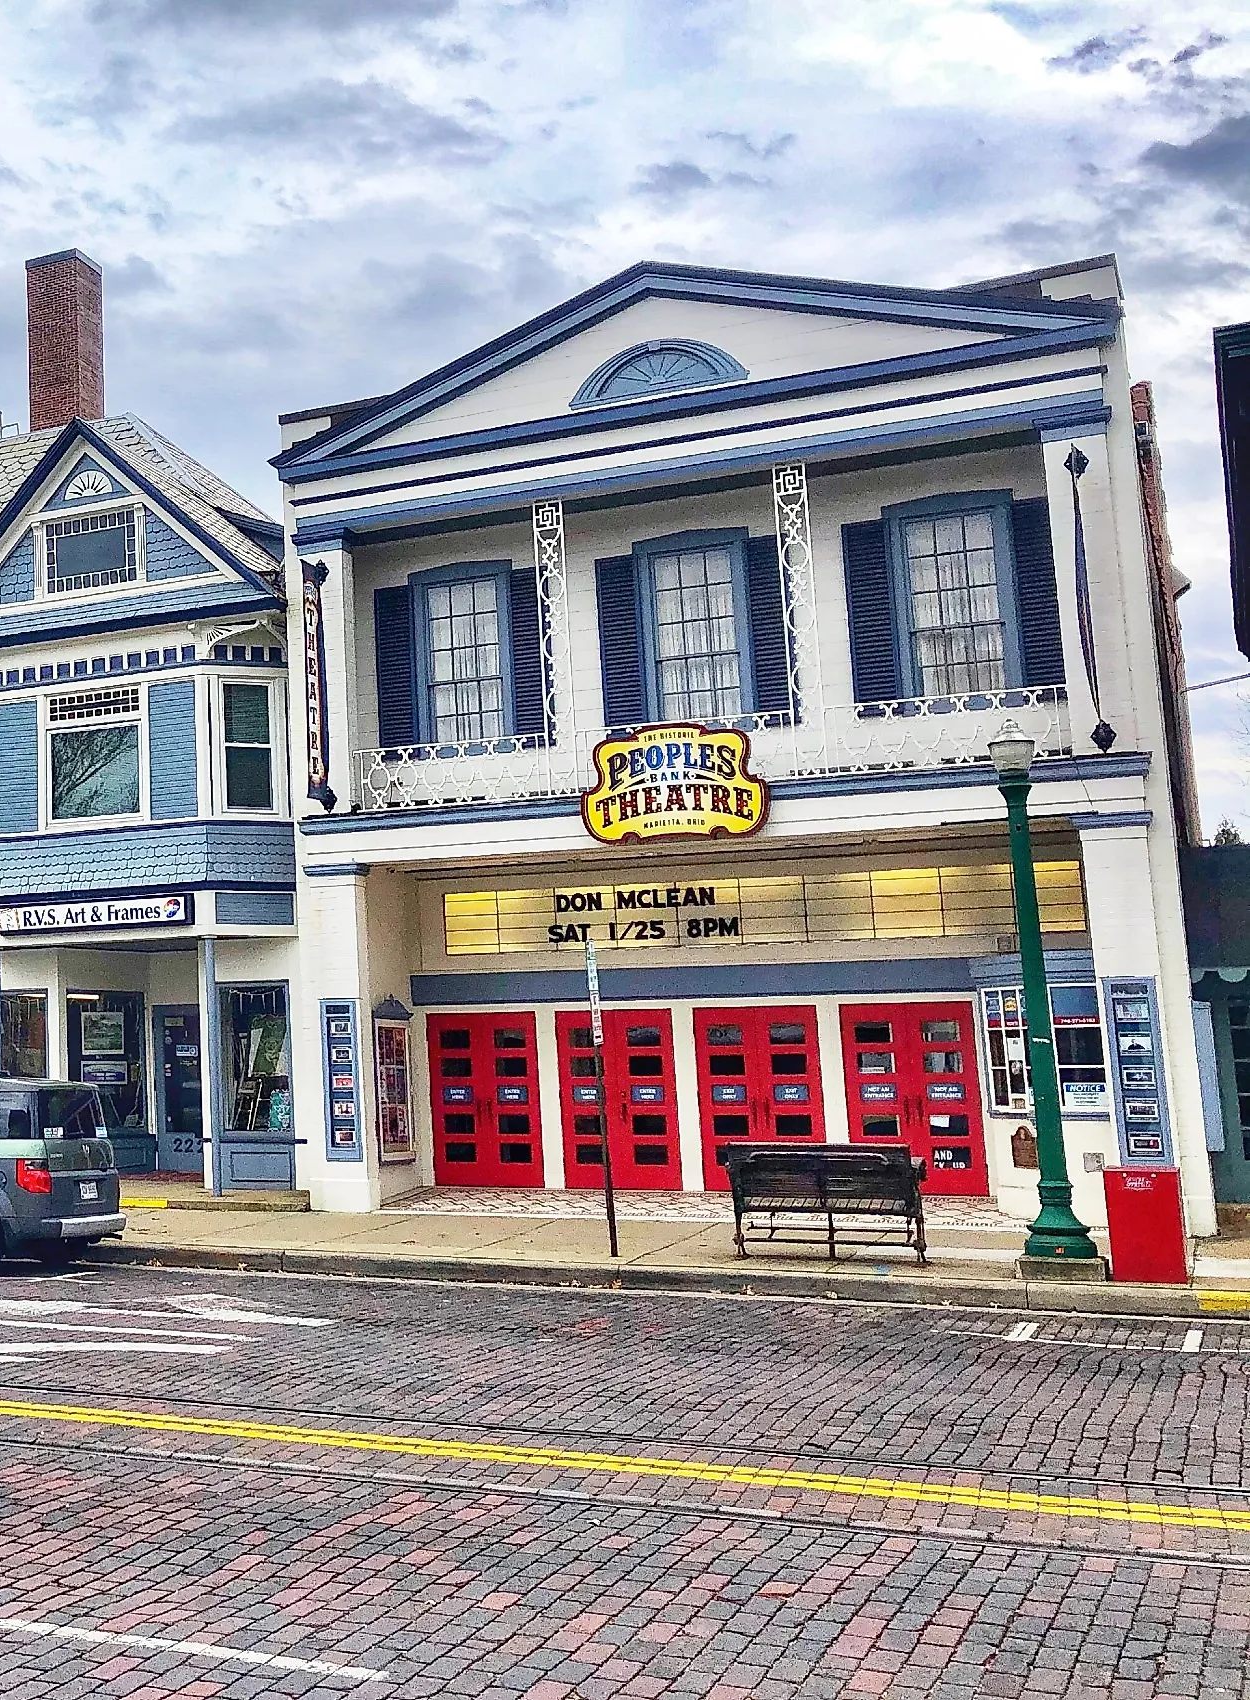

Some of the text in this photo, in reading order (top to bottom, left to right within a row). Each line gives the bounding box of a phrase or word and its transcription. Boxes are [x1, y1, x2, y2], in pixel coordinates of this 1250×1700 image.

[643, 731, 695, 743] THE HISTORIC
[606, 742, 738, 792] PEOPLES
[649, 770, 692, 783] BANK
[595, 783, 754, 829] THEATRE
[686, 818, 706, 827] OHIO
[555, 887, 716, 913] DON MCLEAN
[23, 904, 161, 927] R.V.S. Art & Frames
[547, 917, 740, 943] SAT 1/25 8PM
[1069, 1084, 1101, 1092] NOTICE
[934, 1150, 953, 1161] AND
